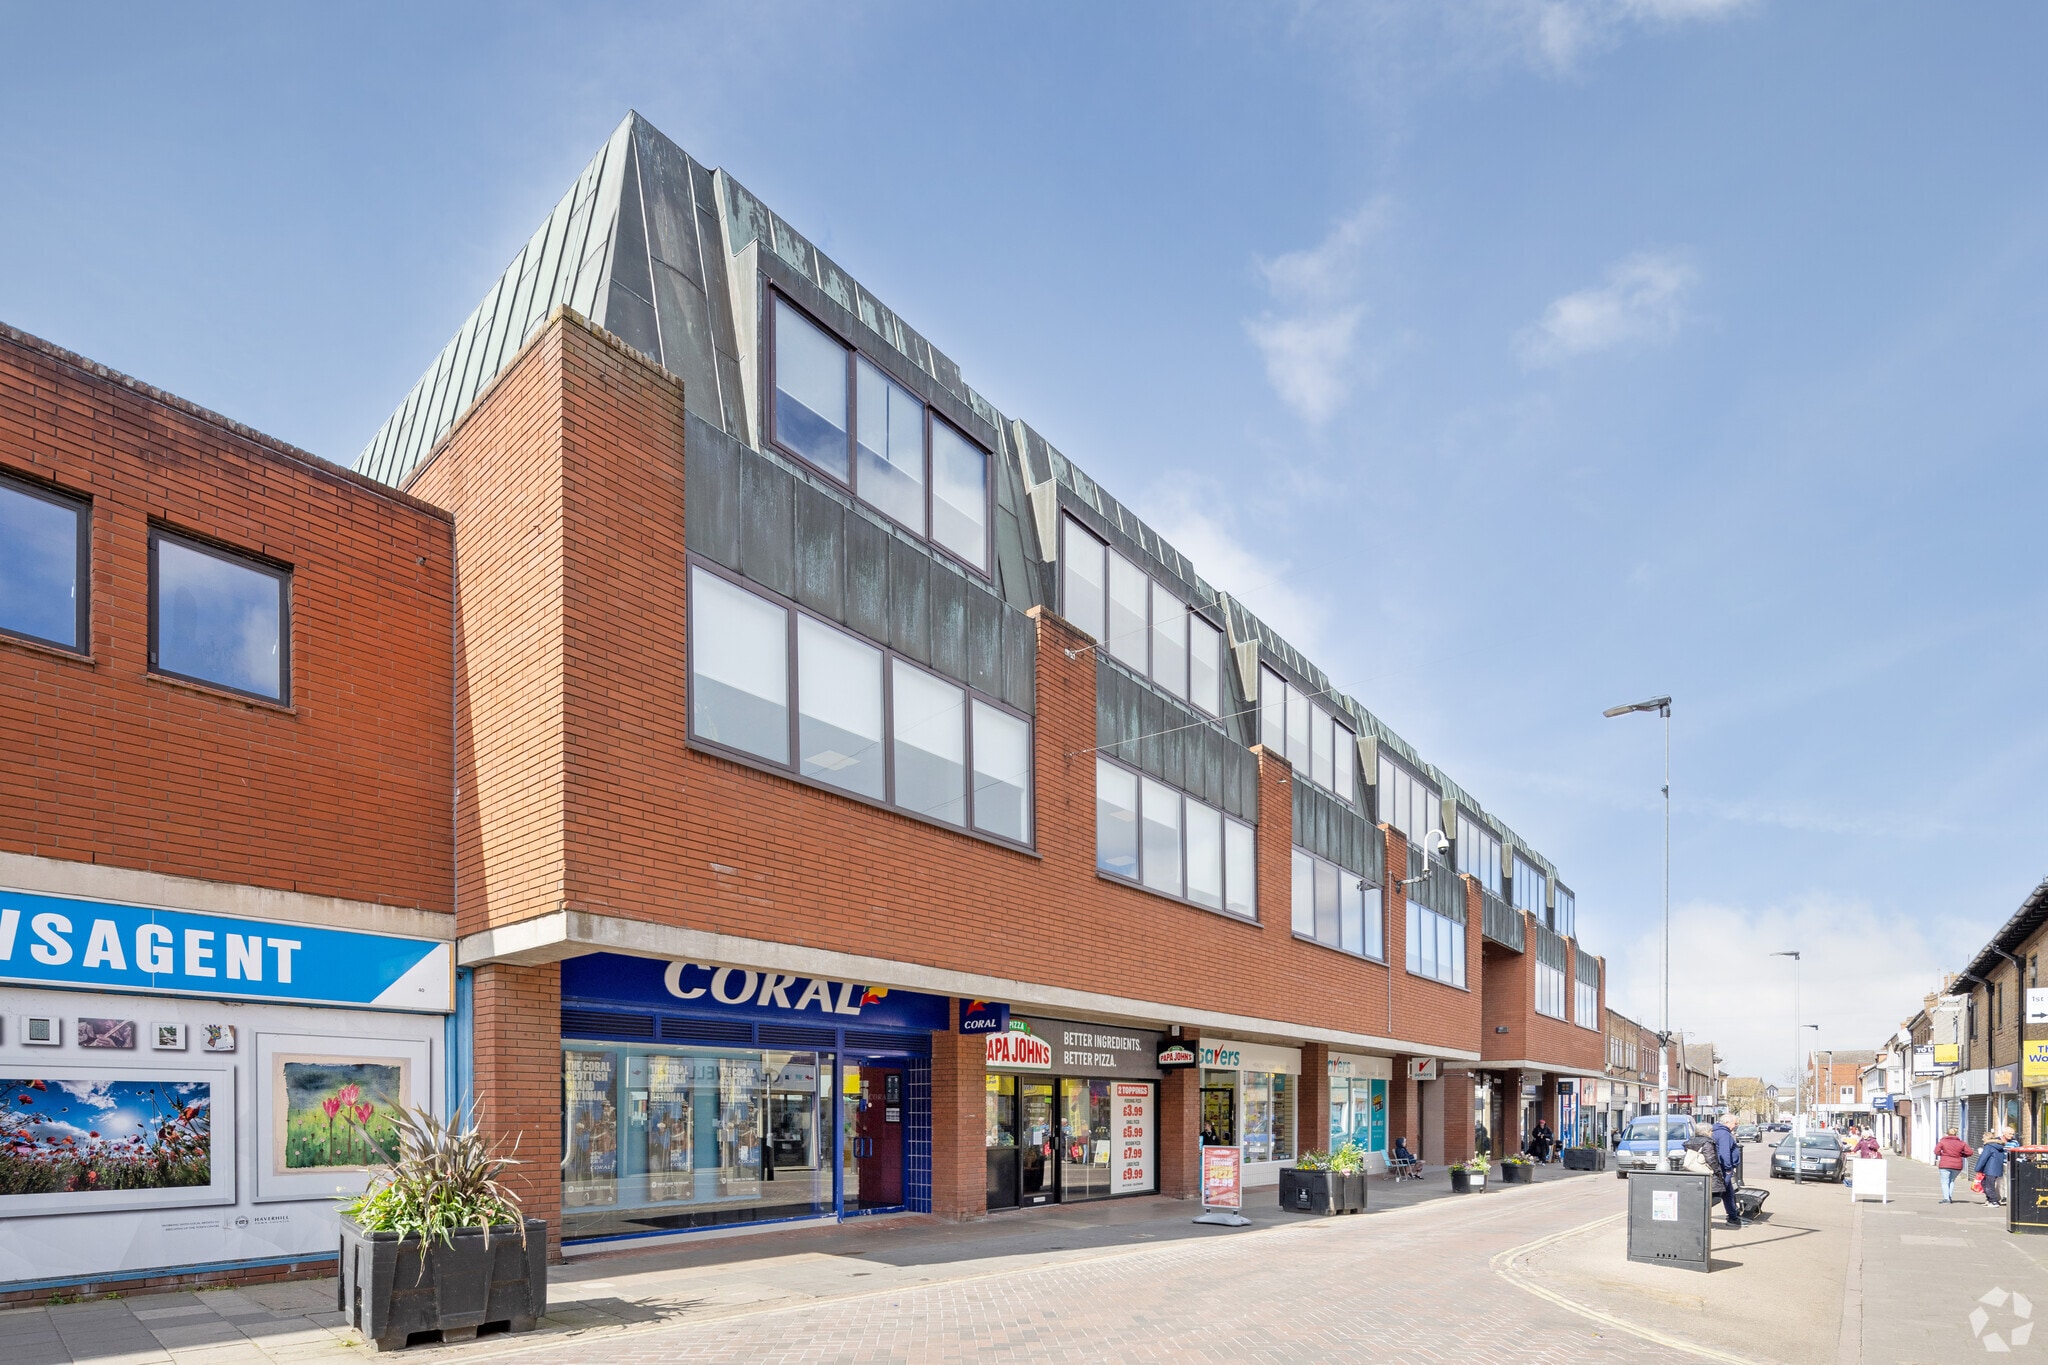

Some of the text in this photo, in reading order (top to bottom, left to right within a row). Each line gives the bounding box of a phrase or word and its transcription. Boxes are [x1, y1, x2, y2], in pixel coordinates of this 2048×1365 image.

[664, 961, 861, 1016] CORAL
[964, 1018, 997, 1030] CORAL
[1008, 1020, 1024, 1030] PIZZA
[1064, 1031, 1142, 1052] BETTER INGREDIENTS.
[987, 1036, 1050, 1065] APA JOHN'S
[1064, 1050, 1117, 1068] BETTER PIZZA.
[1160, 1053, 1173, 1062] PAPA
[566, 1061, 611, 1072] THE CORAL
[665, 1065, 688, 1075] CORAL
[1328, 1056, 1350, 1074] avers
[566, 1071, 608, 1081] SCOTTISH
[733, 1068, 755, 1077] CORAL
[566, 1081, 594, 1090] GRAND
[1122, 1086, 1148, 1095] TOPPINGS
[566, 1090, 607, 1100] NATIONAL
[1123, 1104, 1142, 1116] £3.99
[1123, 1126, 1142, 1138] £5.99
[1124, 1147, 1142, 1159] £7.99
[1123, 1168, 1142, 1180] £9.99
[1210, 1178, 1233, 1187] £2.99
